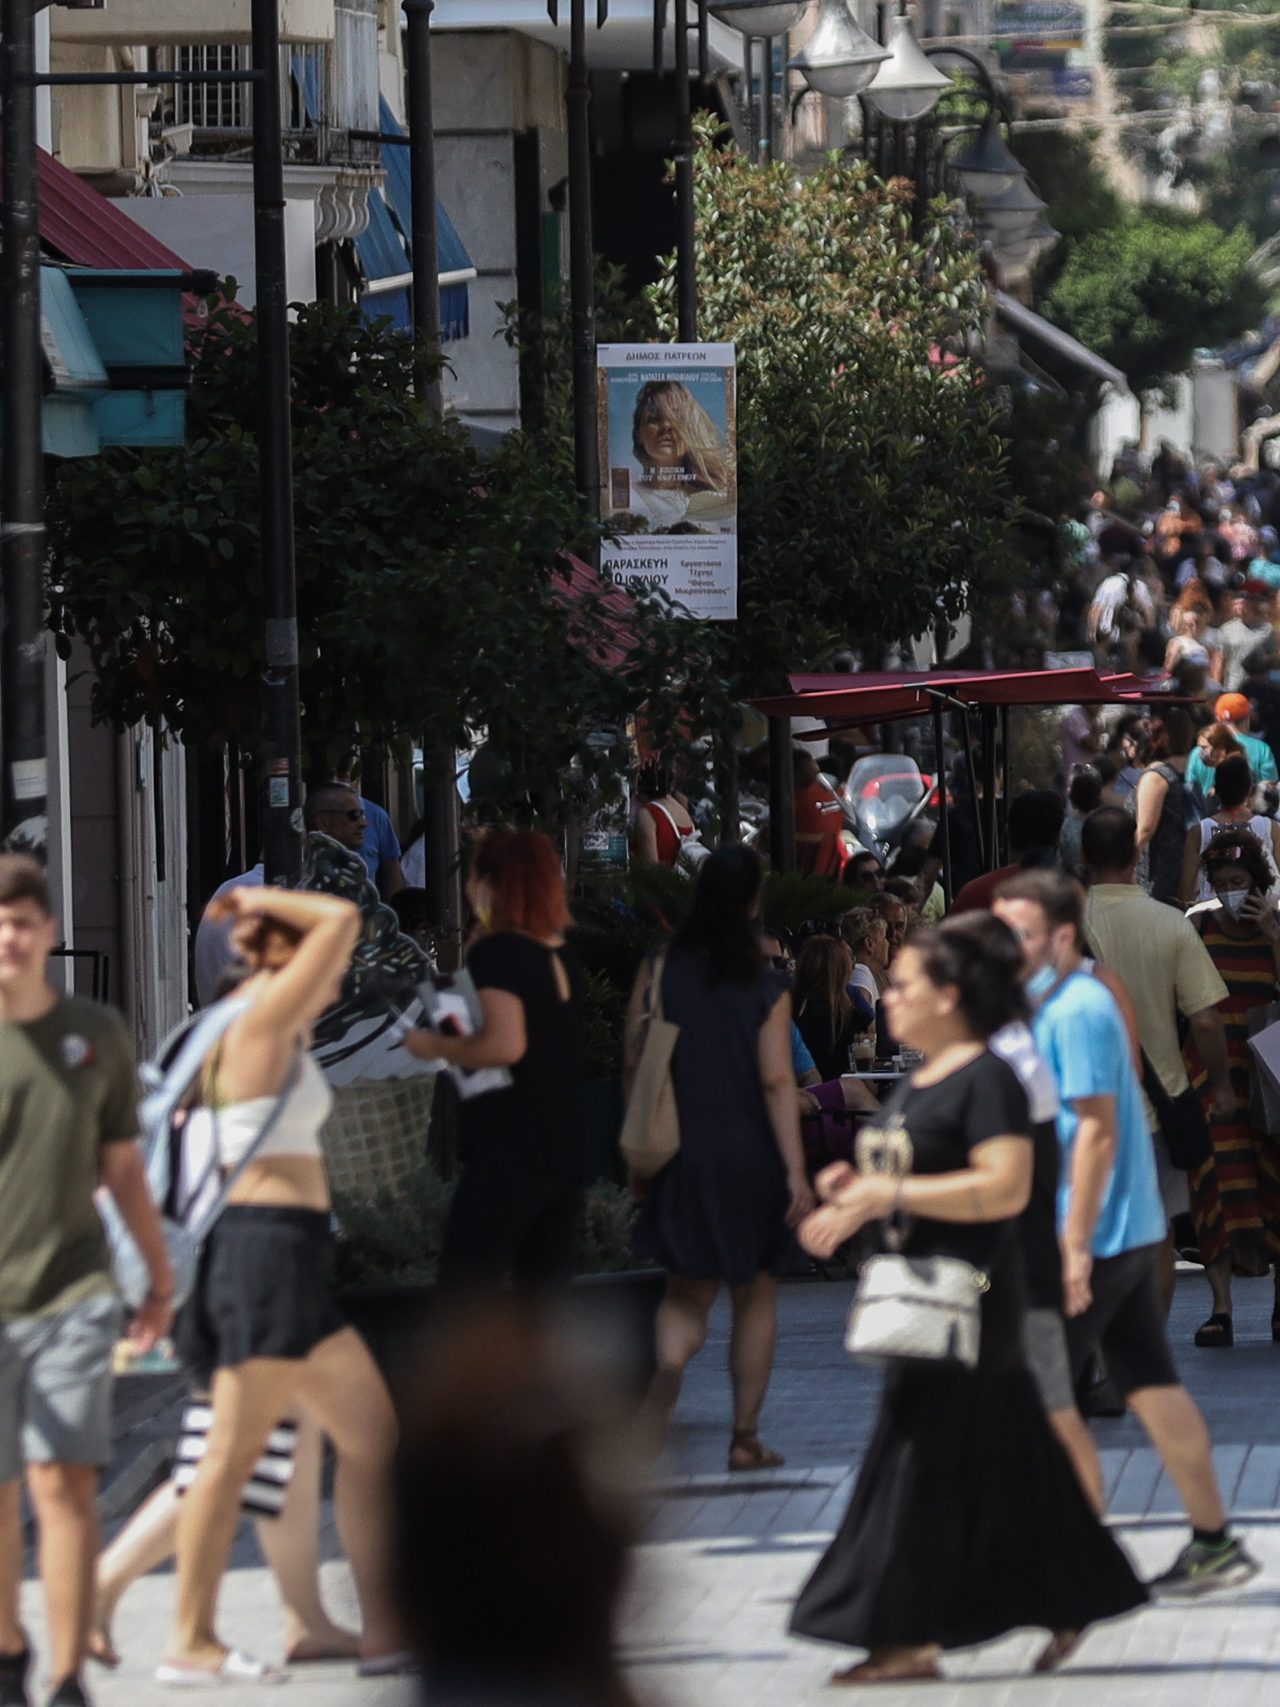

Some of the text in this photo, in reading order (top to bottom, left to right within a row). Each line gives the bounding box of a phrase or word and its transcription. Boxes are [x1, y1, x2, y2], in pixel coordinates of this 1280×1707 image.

[625, 351, 707, 361] ΔΗΜΟΣ ΠΑΤΡΕΩΝ
[605, 557, 668, 569] ΠΑΡΑΣΚΕΥΗ
